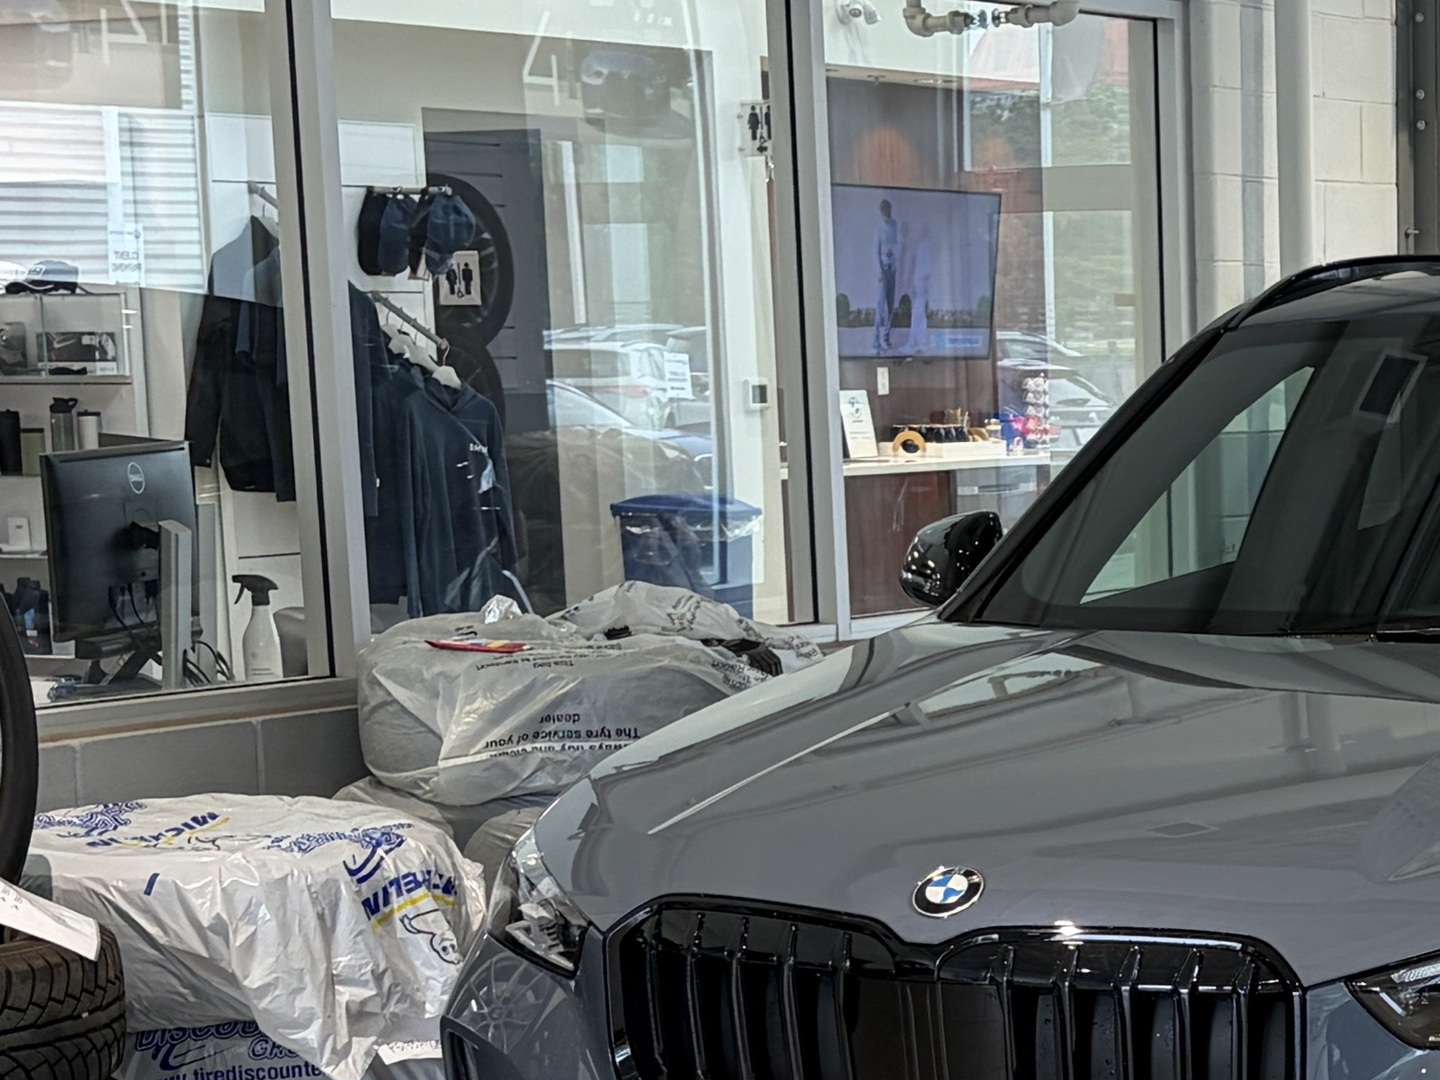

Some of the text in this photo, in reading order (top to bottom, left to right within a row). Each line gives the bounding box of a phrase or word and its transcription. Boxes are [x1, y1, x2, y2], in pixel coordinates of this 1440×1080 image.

[538, 712, 581, 725] dealer
[484, 726, 641, 749] The tyre service of your
